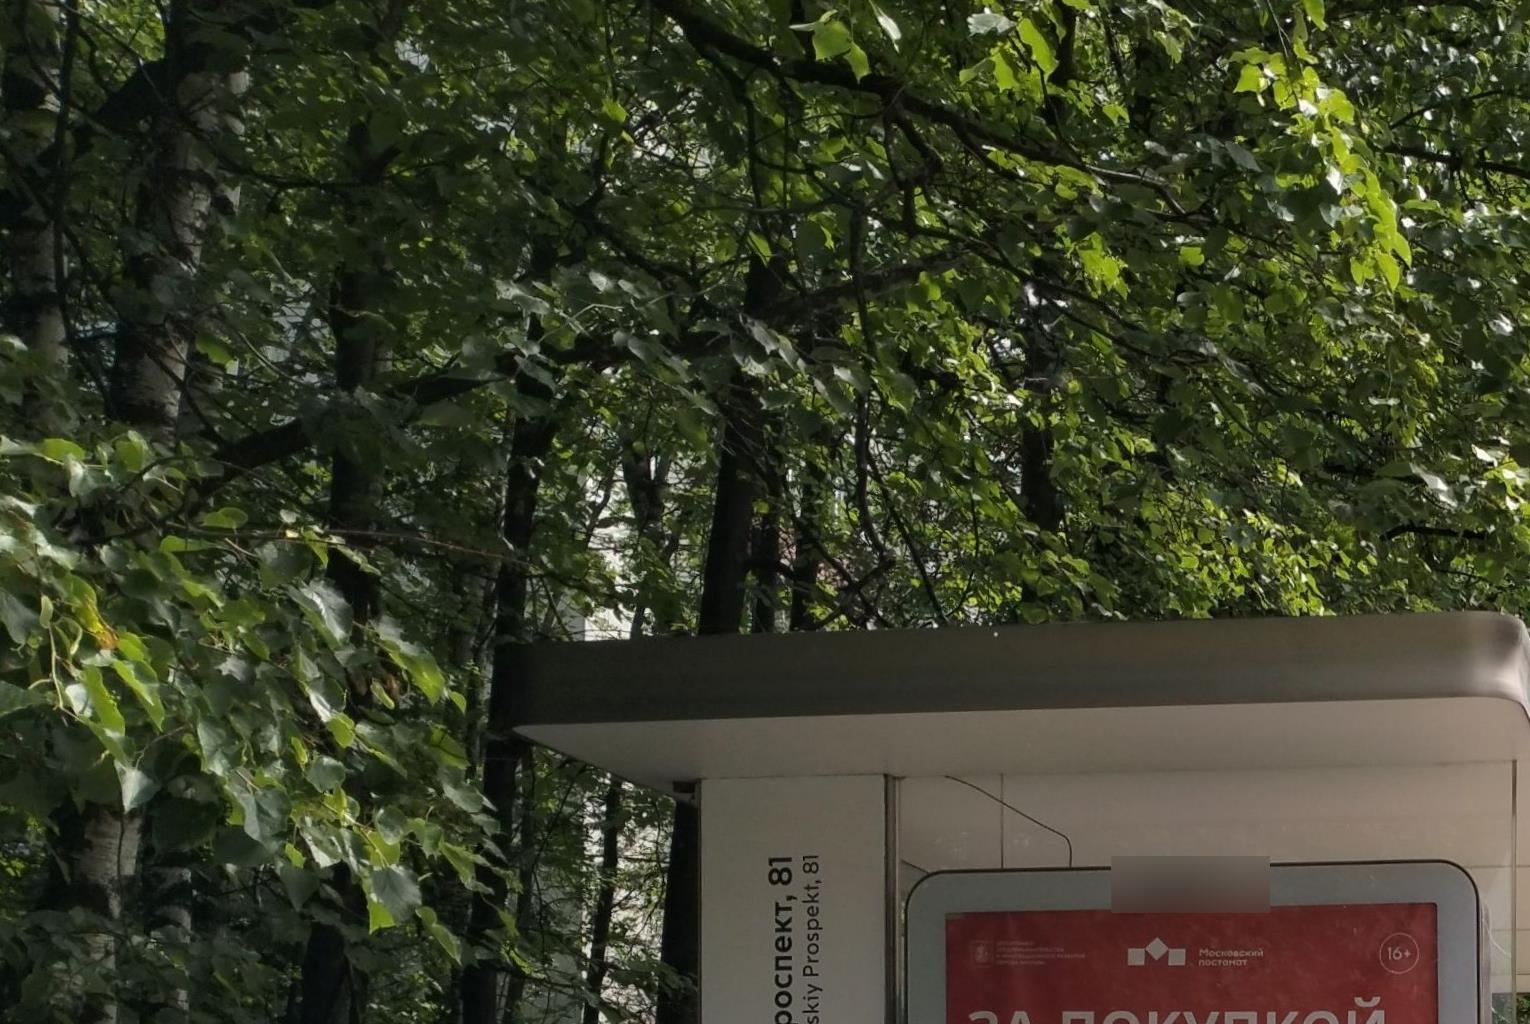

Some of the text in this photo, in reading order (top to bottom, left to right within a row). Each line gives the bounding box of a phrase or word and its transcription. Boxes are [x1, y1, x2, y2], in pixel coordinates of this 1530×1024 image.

[767, 856, 793, 886] 81
[802, 855, 820, 874] 81
[801, 880, 823, 977] Prospekt,
[1387, 946, 1411, 961] 16+
